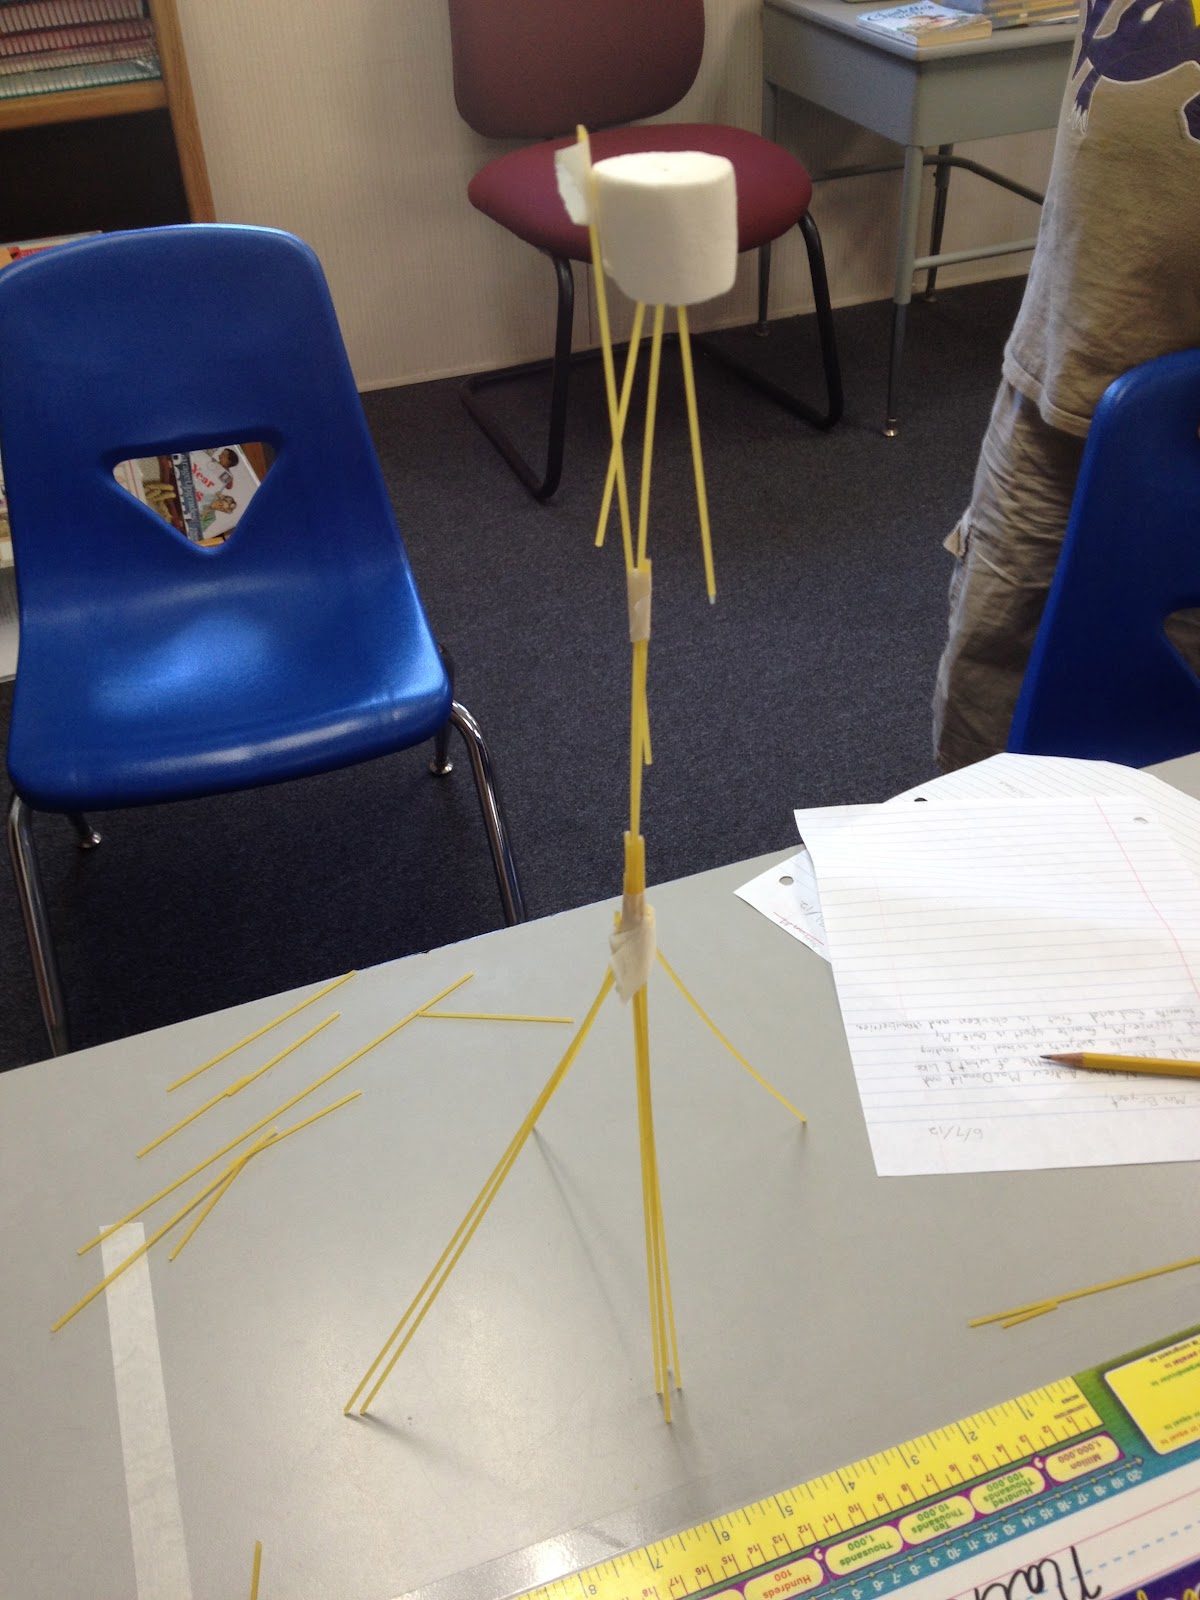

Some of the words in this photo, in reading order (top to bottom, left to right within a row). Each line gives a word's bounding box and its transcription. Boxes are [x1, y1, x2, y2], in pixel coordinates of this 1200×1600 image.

[1026, 1408, 1035, 1418] 1
[969, 1431, 979, 1442] 2
[996, 1444, 1004, 1453] 4
[910, 1454, 920, 1465] 3
[972, 1453, 980, 1462] 5
[1069, 1453, 1103, 1472] Million
[948, 1463, 957, 1472] 6
[924, 1473, 932, 1482] 7
[847, 1480, 857, 1491] 4
[900, 1483, 908, 1492] 8
[983, 1478, 1036, 1504] Thousands
[876, 1493, 884, 1501] 9
[991, 1487, 1034, 1509] Hundred
[784, 1505, 794, 1516] 5
[848, 1503, 860, 1513] 10
[823, 1513, 835, 1524] 11
[911, 1509, 965, 1535] Thousands
[797, 1523, 810, 1535] 12
[932, 1519, 950, 1533] Ten
[721, 1530, 731, 1542] 6
[771, 1532, 785, 1544] 13
[846, 1533, 875, 1552] 1,000
[747, 1543, 759, 1554] 14
[839, 1540, 893, 1568] Thousands
[655, 1558, 664, 1569] 7
[721, 1554, 733, 1565] 15
[928, 1556, 940, 1568] -9
[695, 1565, 707, 1575] 16
[773, 1568, 793, 1582] 100
[909, 1564, 921, 1576] -8
[669, 1576, 680, 1587] 17
[892, 1572, 902, 1584] -7
[588, 1584, 598, 1596] 8
[762, 1573, 812, 1599] Hundreds
[642, 1587, 654, 1597] 18
